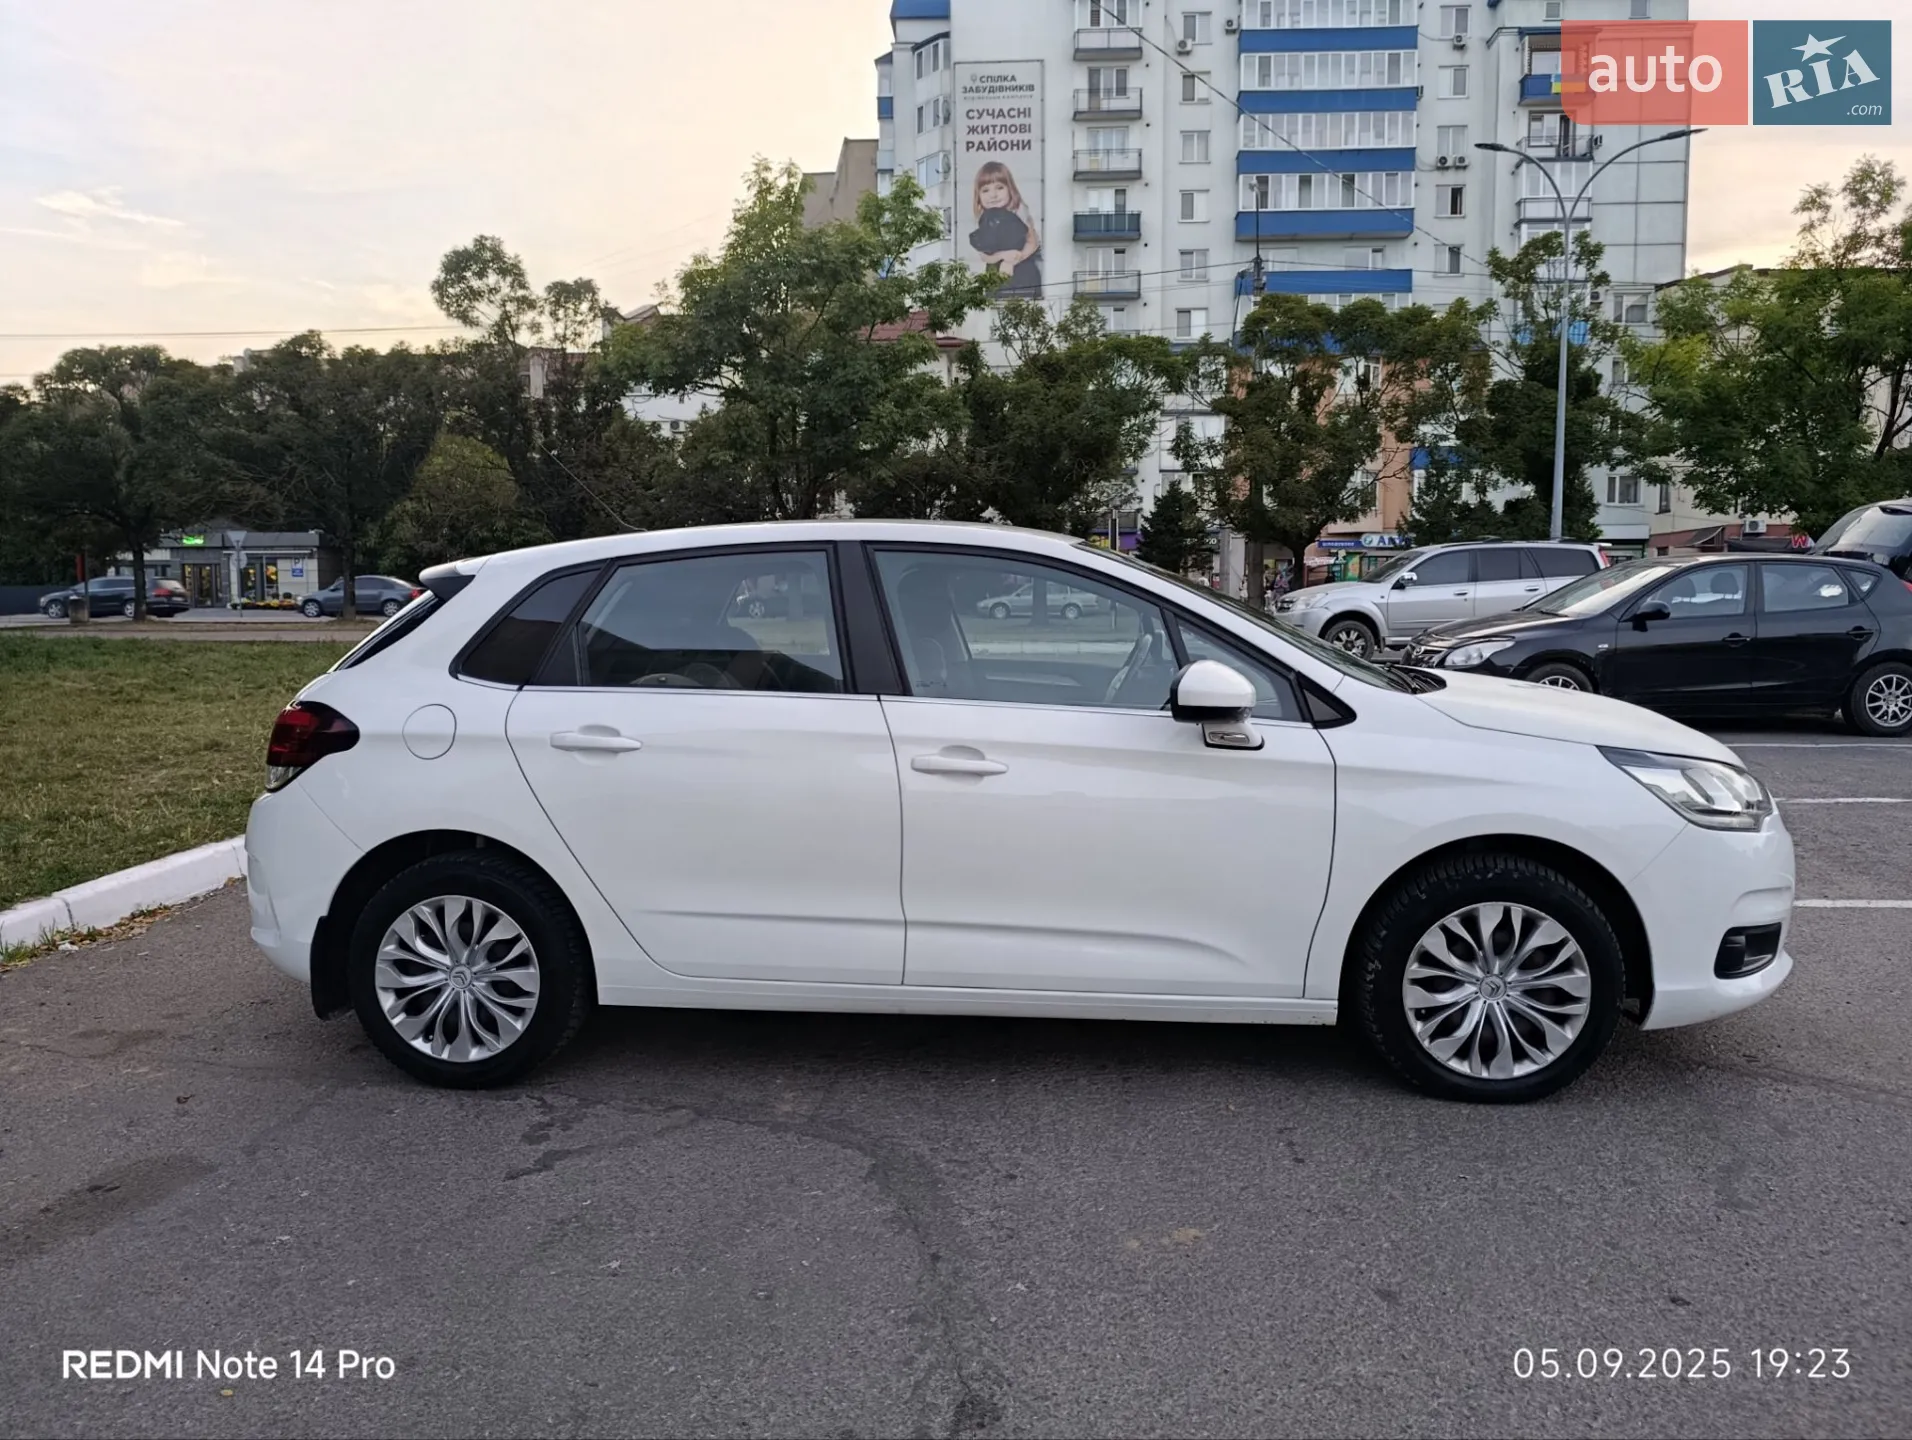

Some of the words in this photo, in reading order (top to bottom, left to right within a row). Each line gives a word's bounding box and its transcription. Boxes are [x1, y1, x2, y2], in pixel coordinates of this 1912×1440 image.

[979, 74, 1017, 84] СПІЛКА
[961, 84, 1035, 94] ЗАБУДІВНИКІВ
[965, 107, 1031, 120] СУЧАСНІ
[966, 122, 1032, 136] ЖИТЛОВІ
[965, 136, 1032, 153] РАЙОНИ
